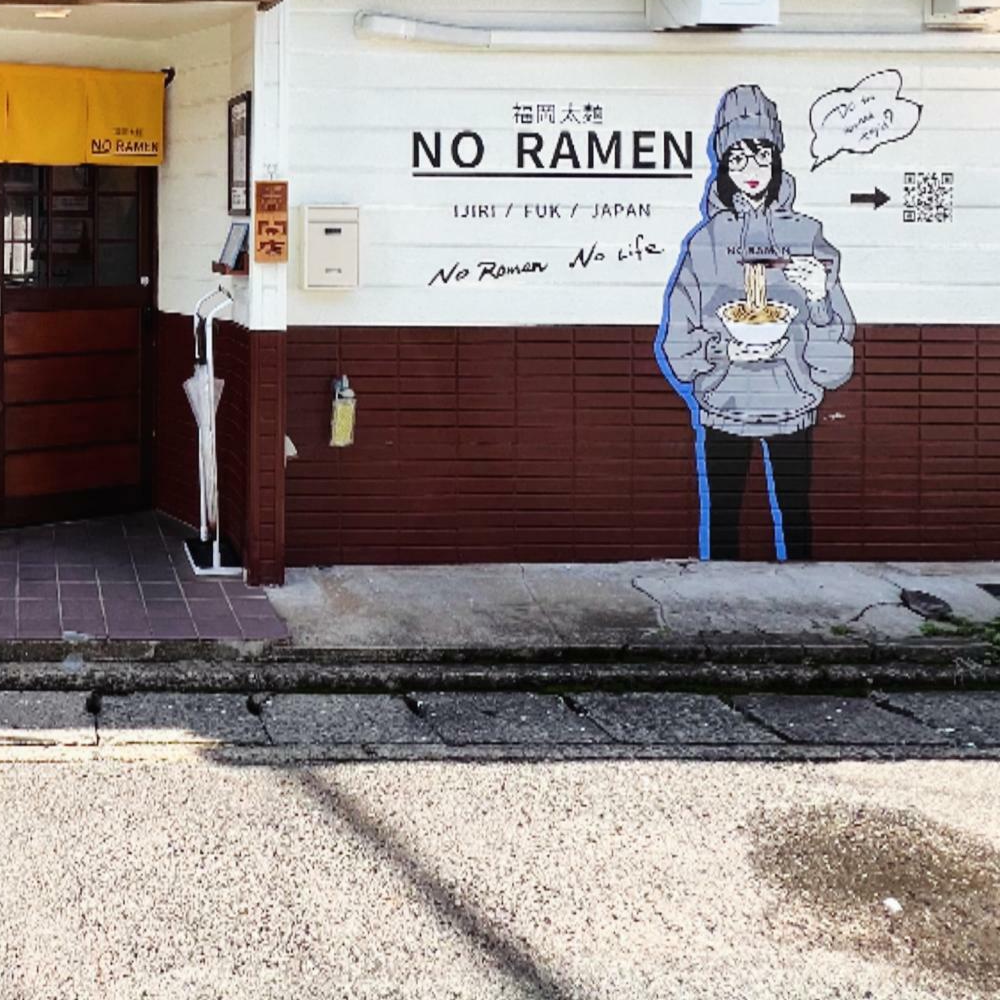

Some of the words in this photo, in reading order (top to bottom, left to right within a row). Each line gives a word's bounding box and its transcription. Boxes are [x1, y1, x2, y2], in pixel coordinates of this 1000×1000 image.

[91, 139, 112, 153] NO
[116, 139, 158, 153] RAMEN
[412, 131, 484, 168] NO
[517, 131, 692, 168] RAMEN
[454, 204, 495, 218] IJIRI
[525, 204, 561, 218] FUK
[592, 204, 651, 218] JAPAN
[428, 262, 469, 286] No
[569, 241, 604, 268] No
